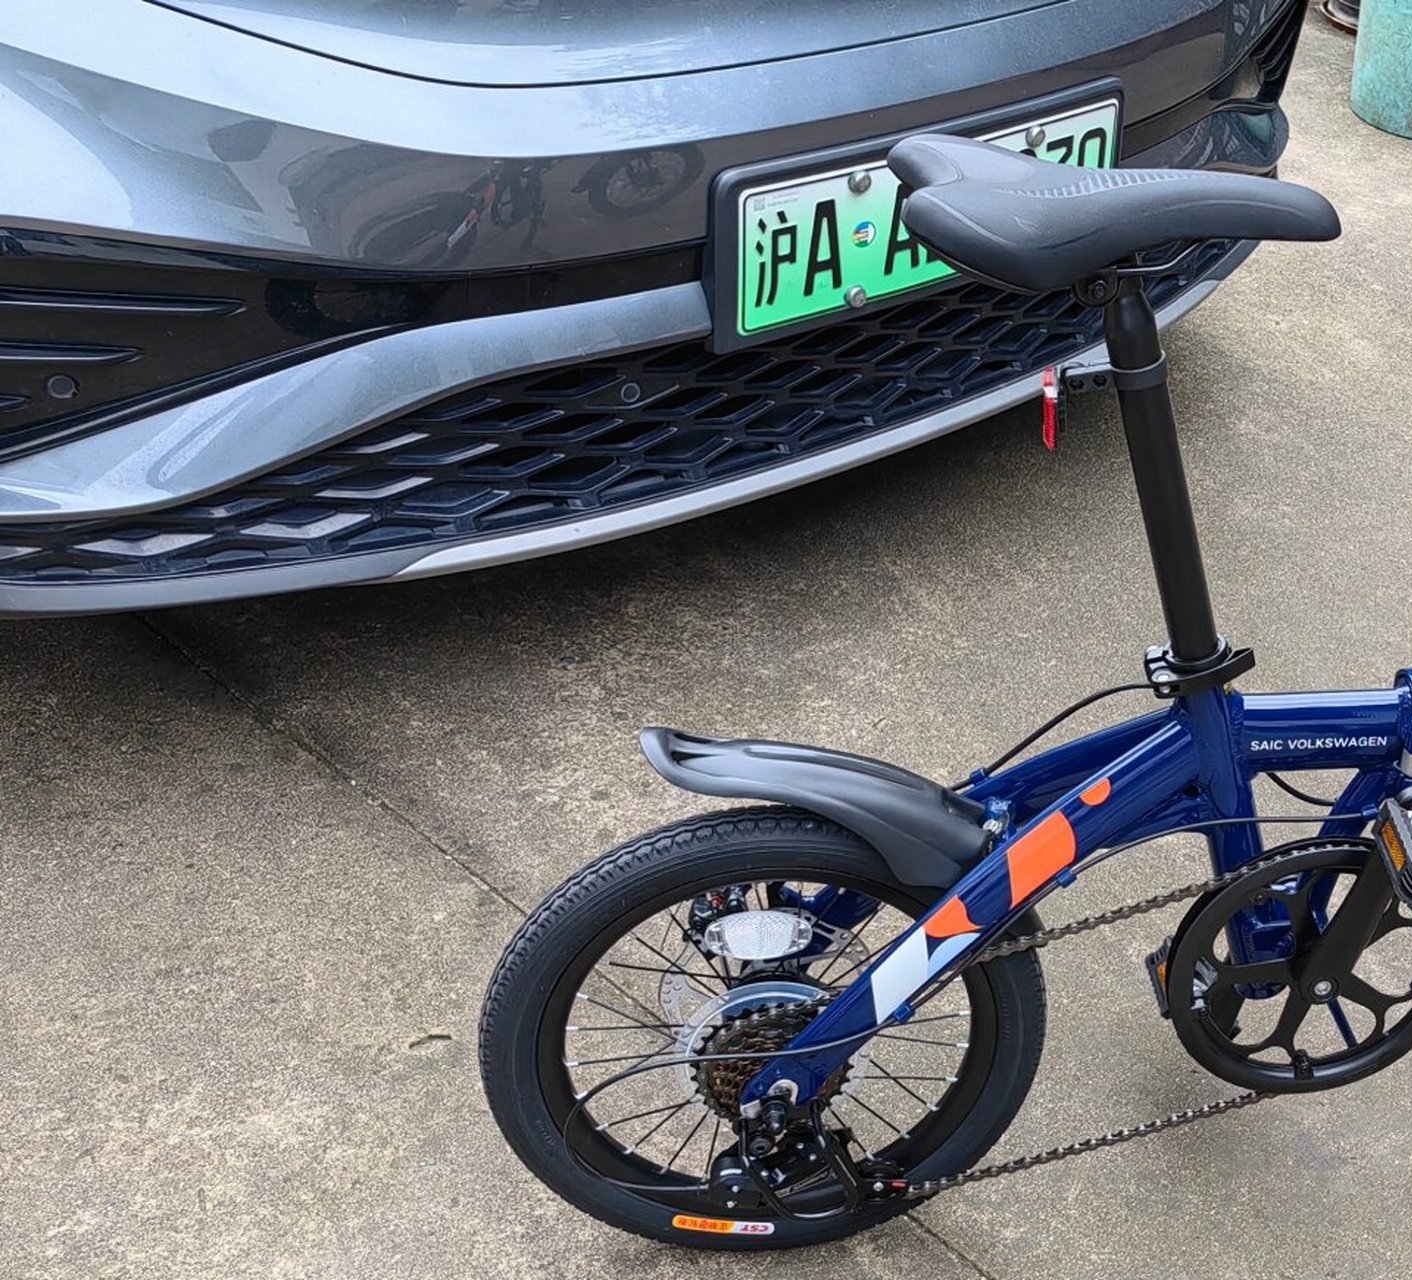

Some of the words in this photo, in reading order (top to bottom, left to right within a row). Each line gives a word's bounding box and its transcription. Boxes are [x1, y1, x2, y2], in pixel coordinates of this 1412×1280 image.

[1250, 739, 1284, 751] SAIC
[1288, 736, 1387, 750] VOLKSWAGEN
[741, 1224, 769, 1233] CST
